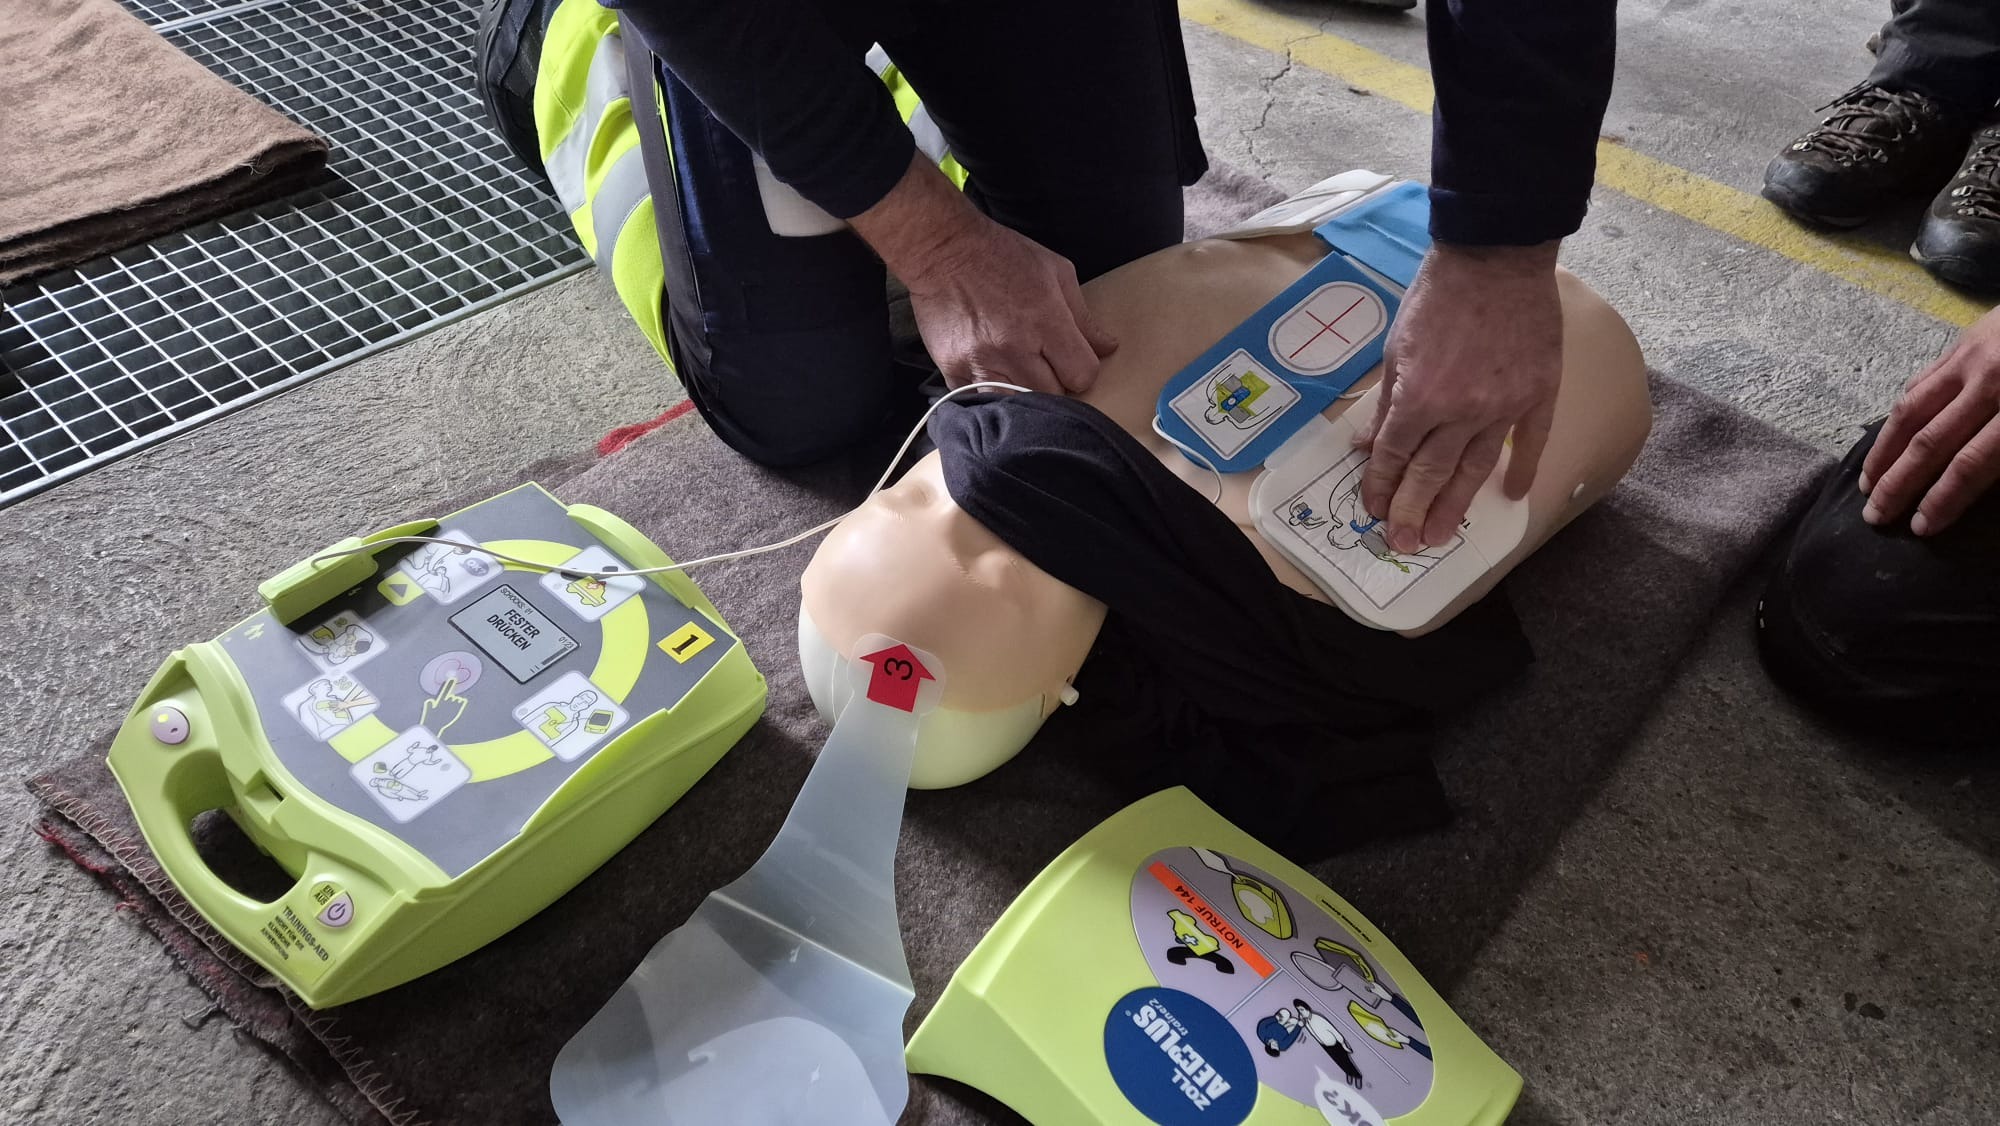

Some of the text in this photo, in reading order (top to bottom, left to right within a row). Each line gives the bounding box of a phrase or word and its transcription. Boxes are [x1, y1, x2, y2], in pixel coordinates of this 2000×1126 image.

[486, 614, 532, 651] DRÜCKEN
[504, 608, 541, 639] FESTER
[671, 634, 700, 655] 1
[883, 657, 914, 681] 3
[313, 893, 328, 906] AUS
[282, 905, 330, 962] TRAININGS-AED
[1174, 885, 1244, 949] NOTRUF 144
[1171, 1067, 1212, 1112] ZOLL
